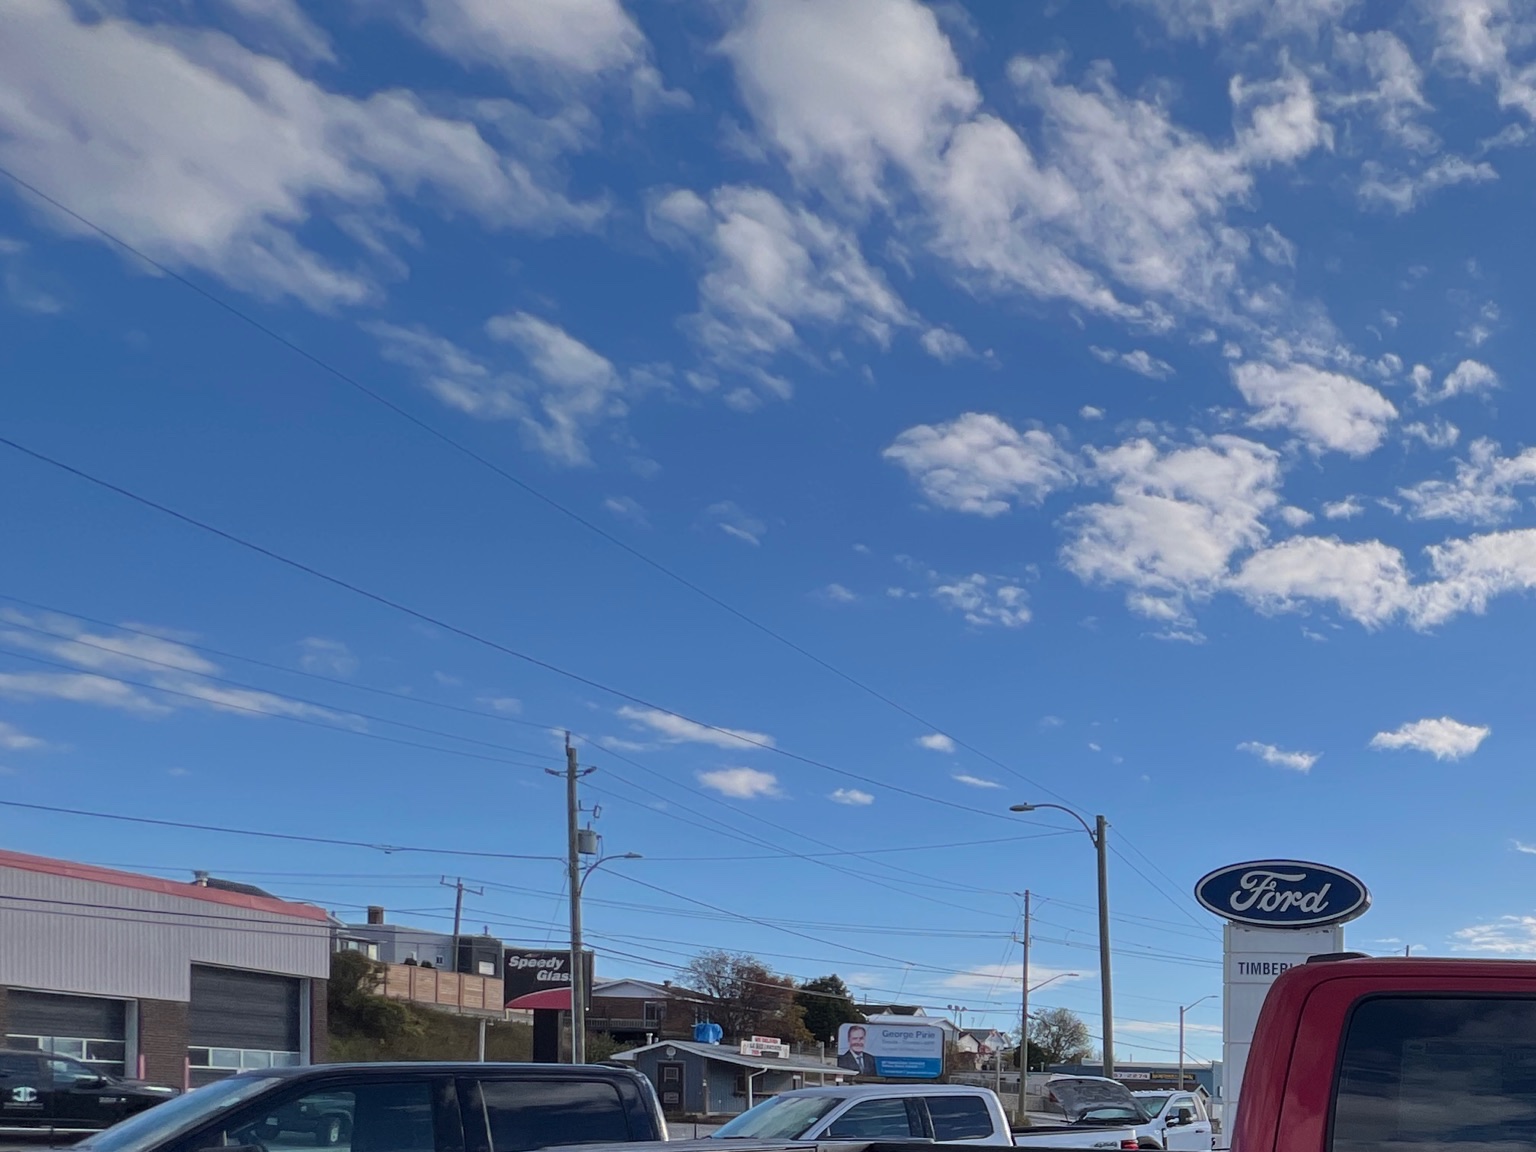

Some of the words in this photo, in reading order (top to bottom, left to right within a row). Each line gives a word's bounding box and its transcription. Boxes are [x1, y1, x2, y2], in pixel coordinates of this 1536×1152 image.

[1230, 870, 1332, 914] Ford
[508, 956, 565, 970] Speedy
[882, 1030, 914, 1040] George
[915, 1030, 935, 1039] Pirie
